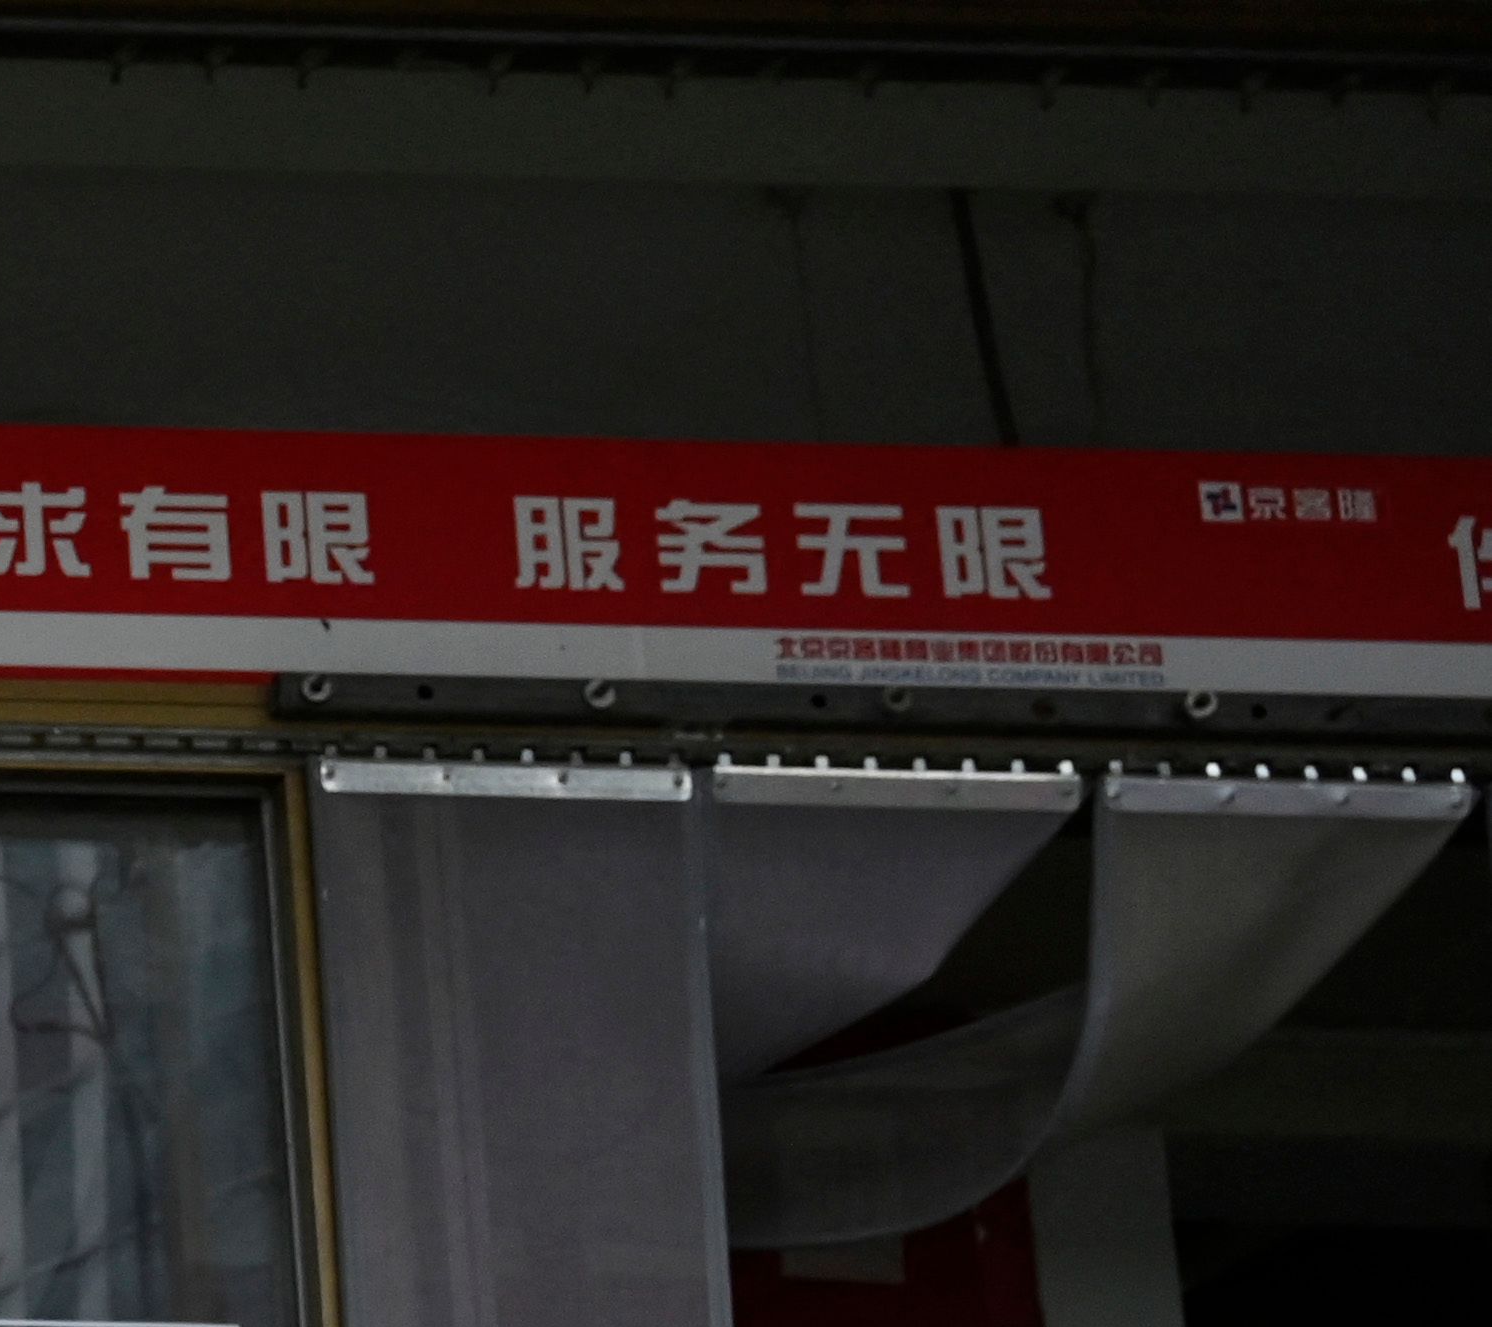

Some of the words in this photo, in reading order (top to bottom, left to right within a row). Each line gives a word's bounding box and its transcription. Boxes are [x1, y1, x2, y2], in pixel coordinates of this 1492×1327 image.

[1249, 486, 1378, 522] 京客隆
[513, 495, 1052, 599] 服务无限
